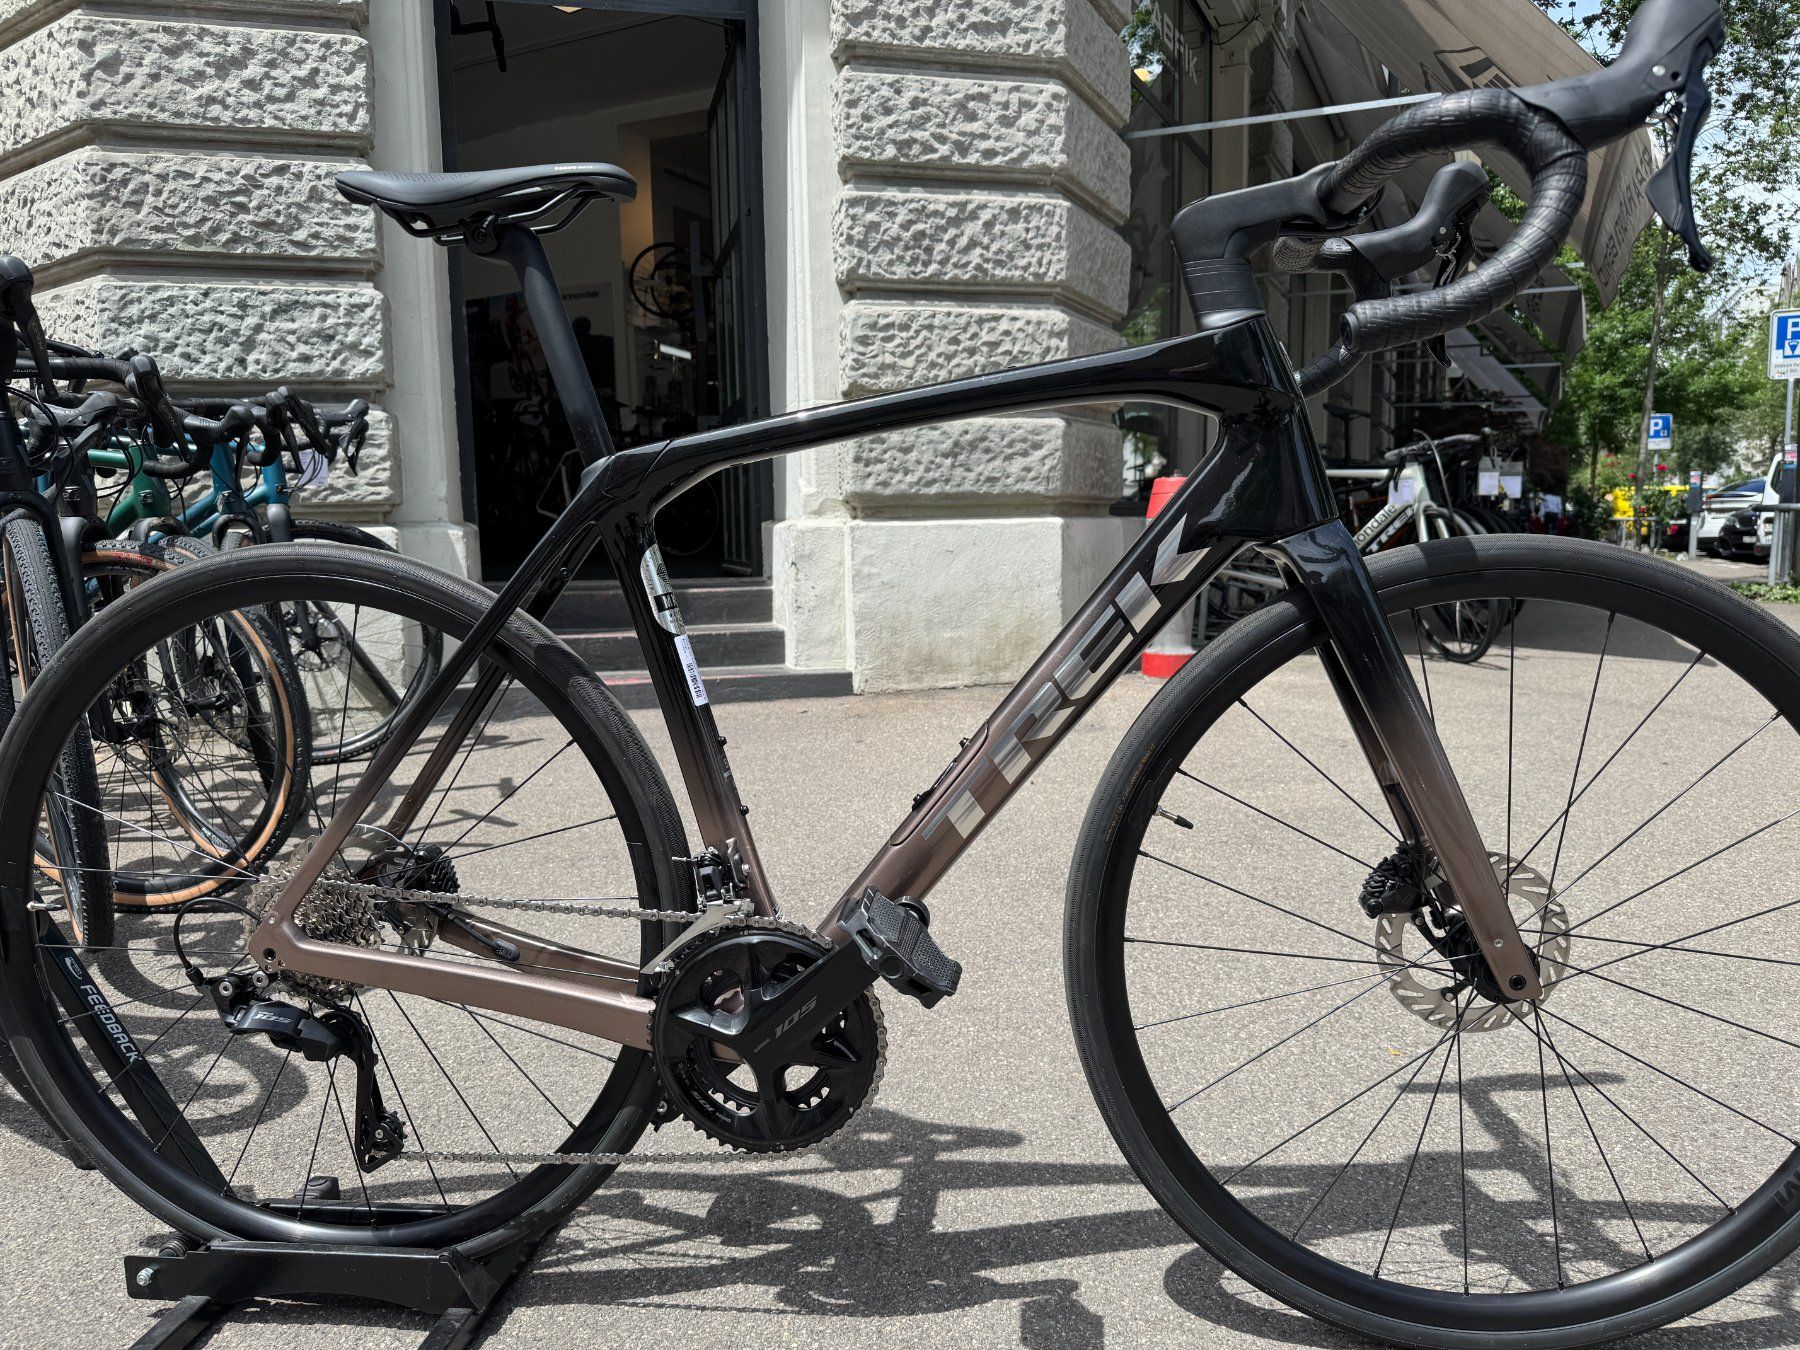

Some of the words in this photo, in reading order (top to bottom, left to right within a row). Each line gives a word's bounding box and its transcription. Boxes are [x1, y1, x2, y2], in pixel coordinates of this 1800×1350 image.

[1650, 418, 1663, 436] P
[922, 512, 1211, 840] TREK
[80, 984, 143, 1062] FEEDBACK
[774, 995, 818, 1039] 105
